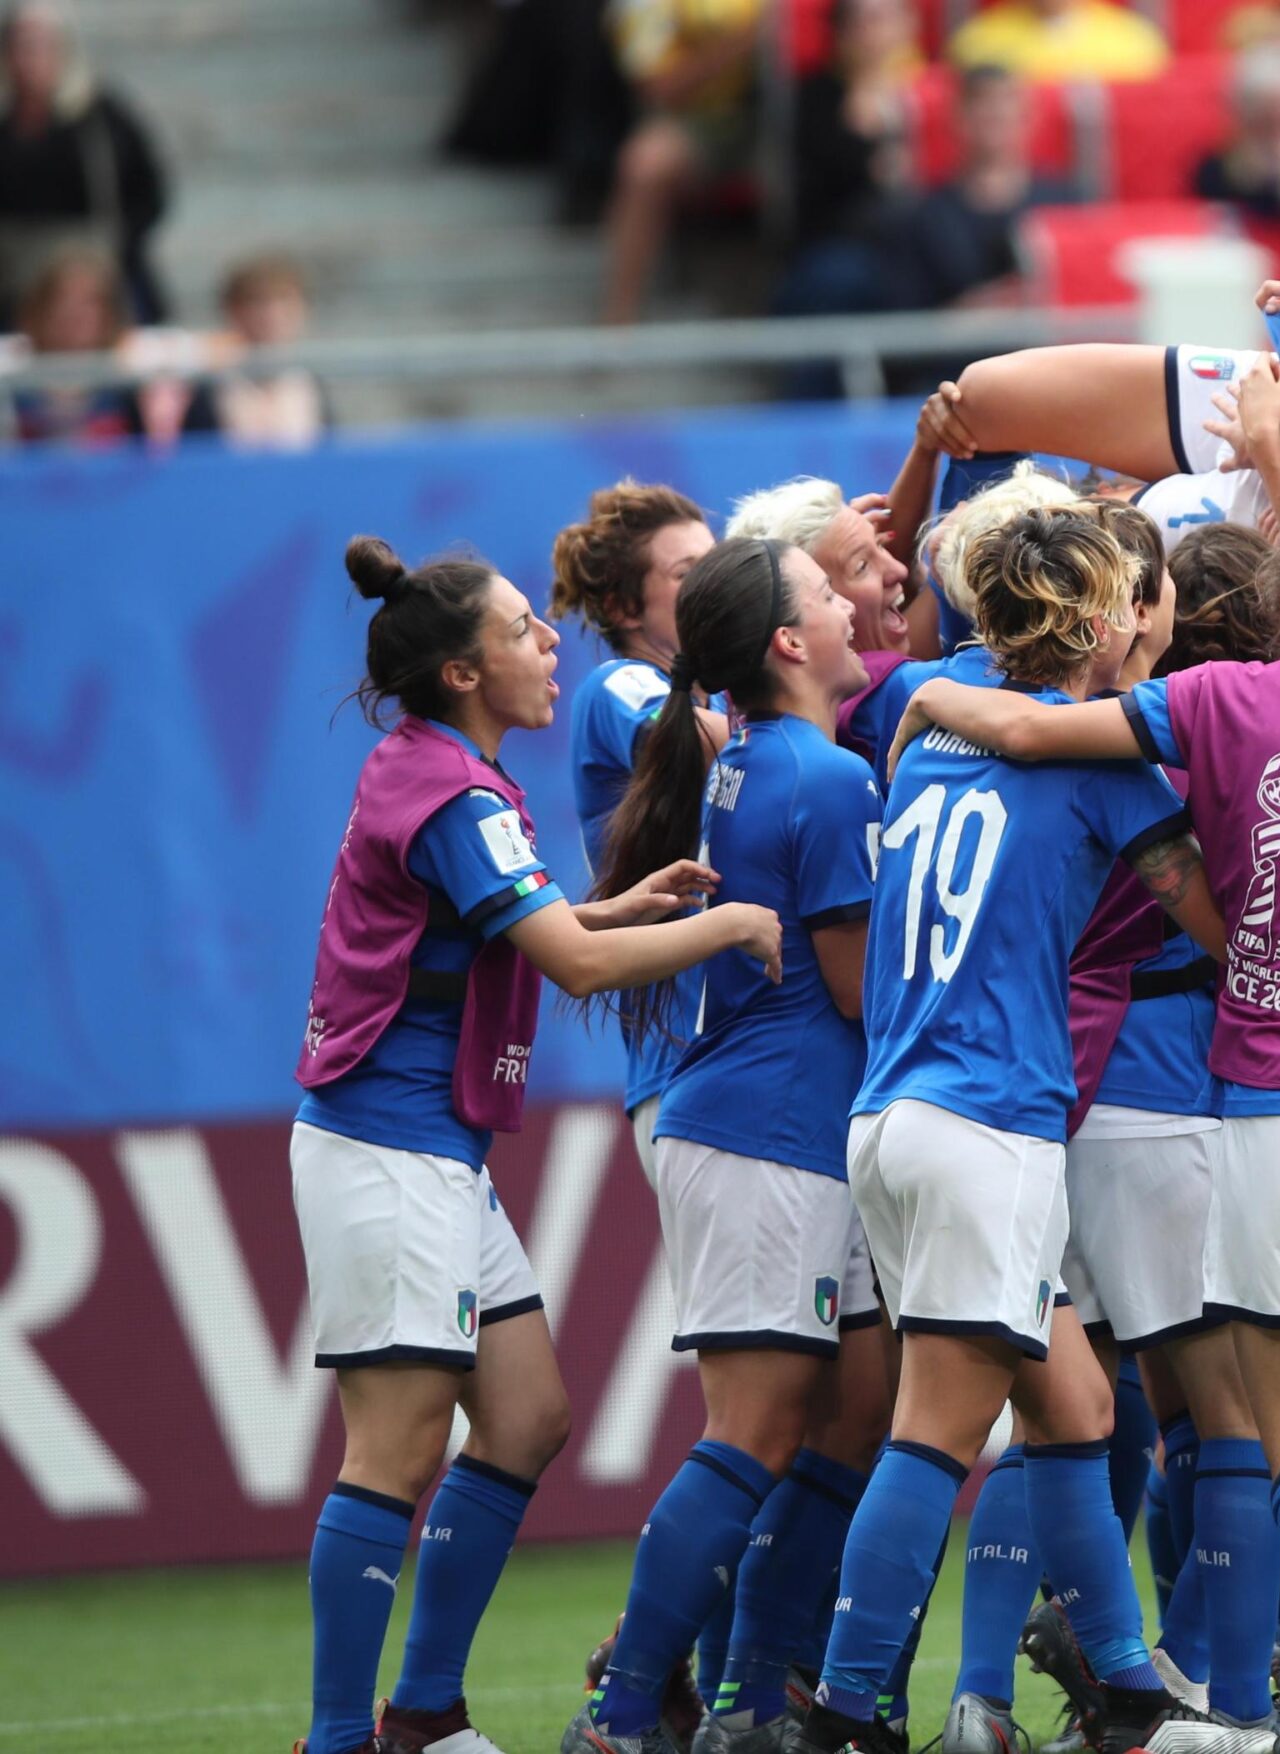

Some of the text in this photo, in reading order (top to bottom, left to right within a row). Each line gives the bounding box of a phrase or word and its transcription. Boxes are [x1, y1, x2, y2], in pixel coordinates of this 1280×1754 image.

[882, 783, 1008, 984] 19
[1237, 929, 1266, 952] FIFA
[967, 1543, 1029, 1564] ITALIA
[1195, 1549, 1230, 1567] ALIA
